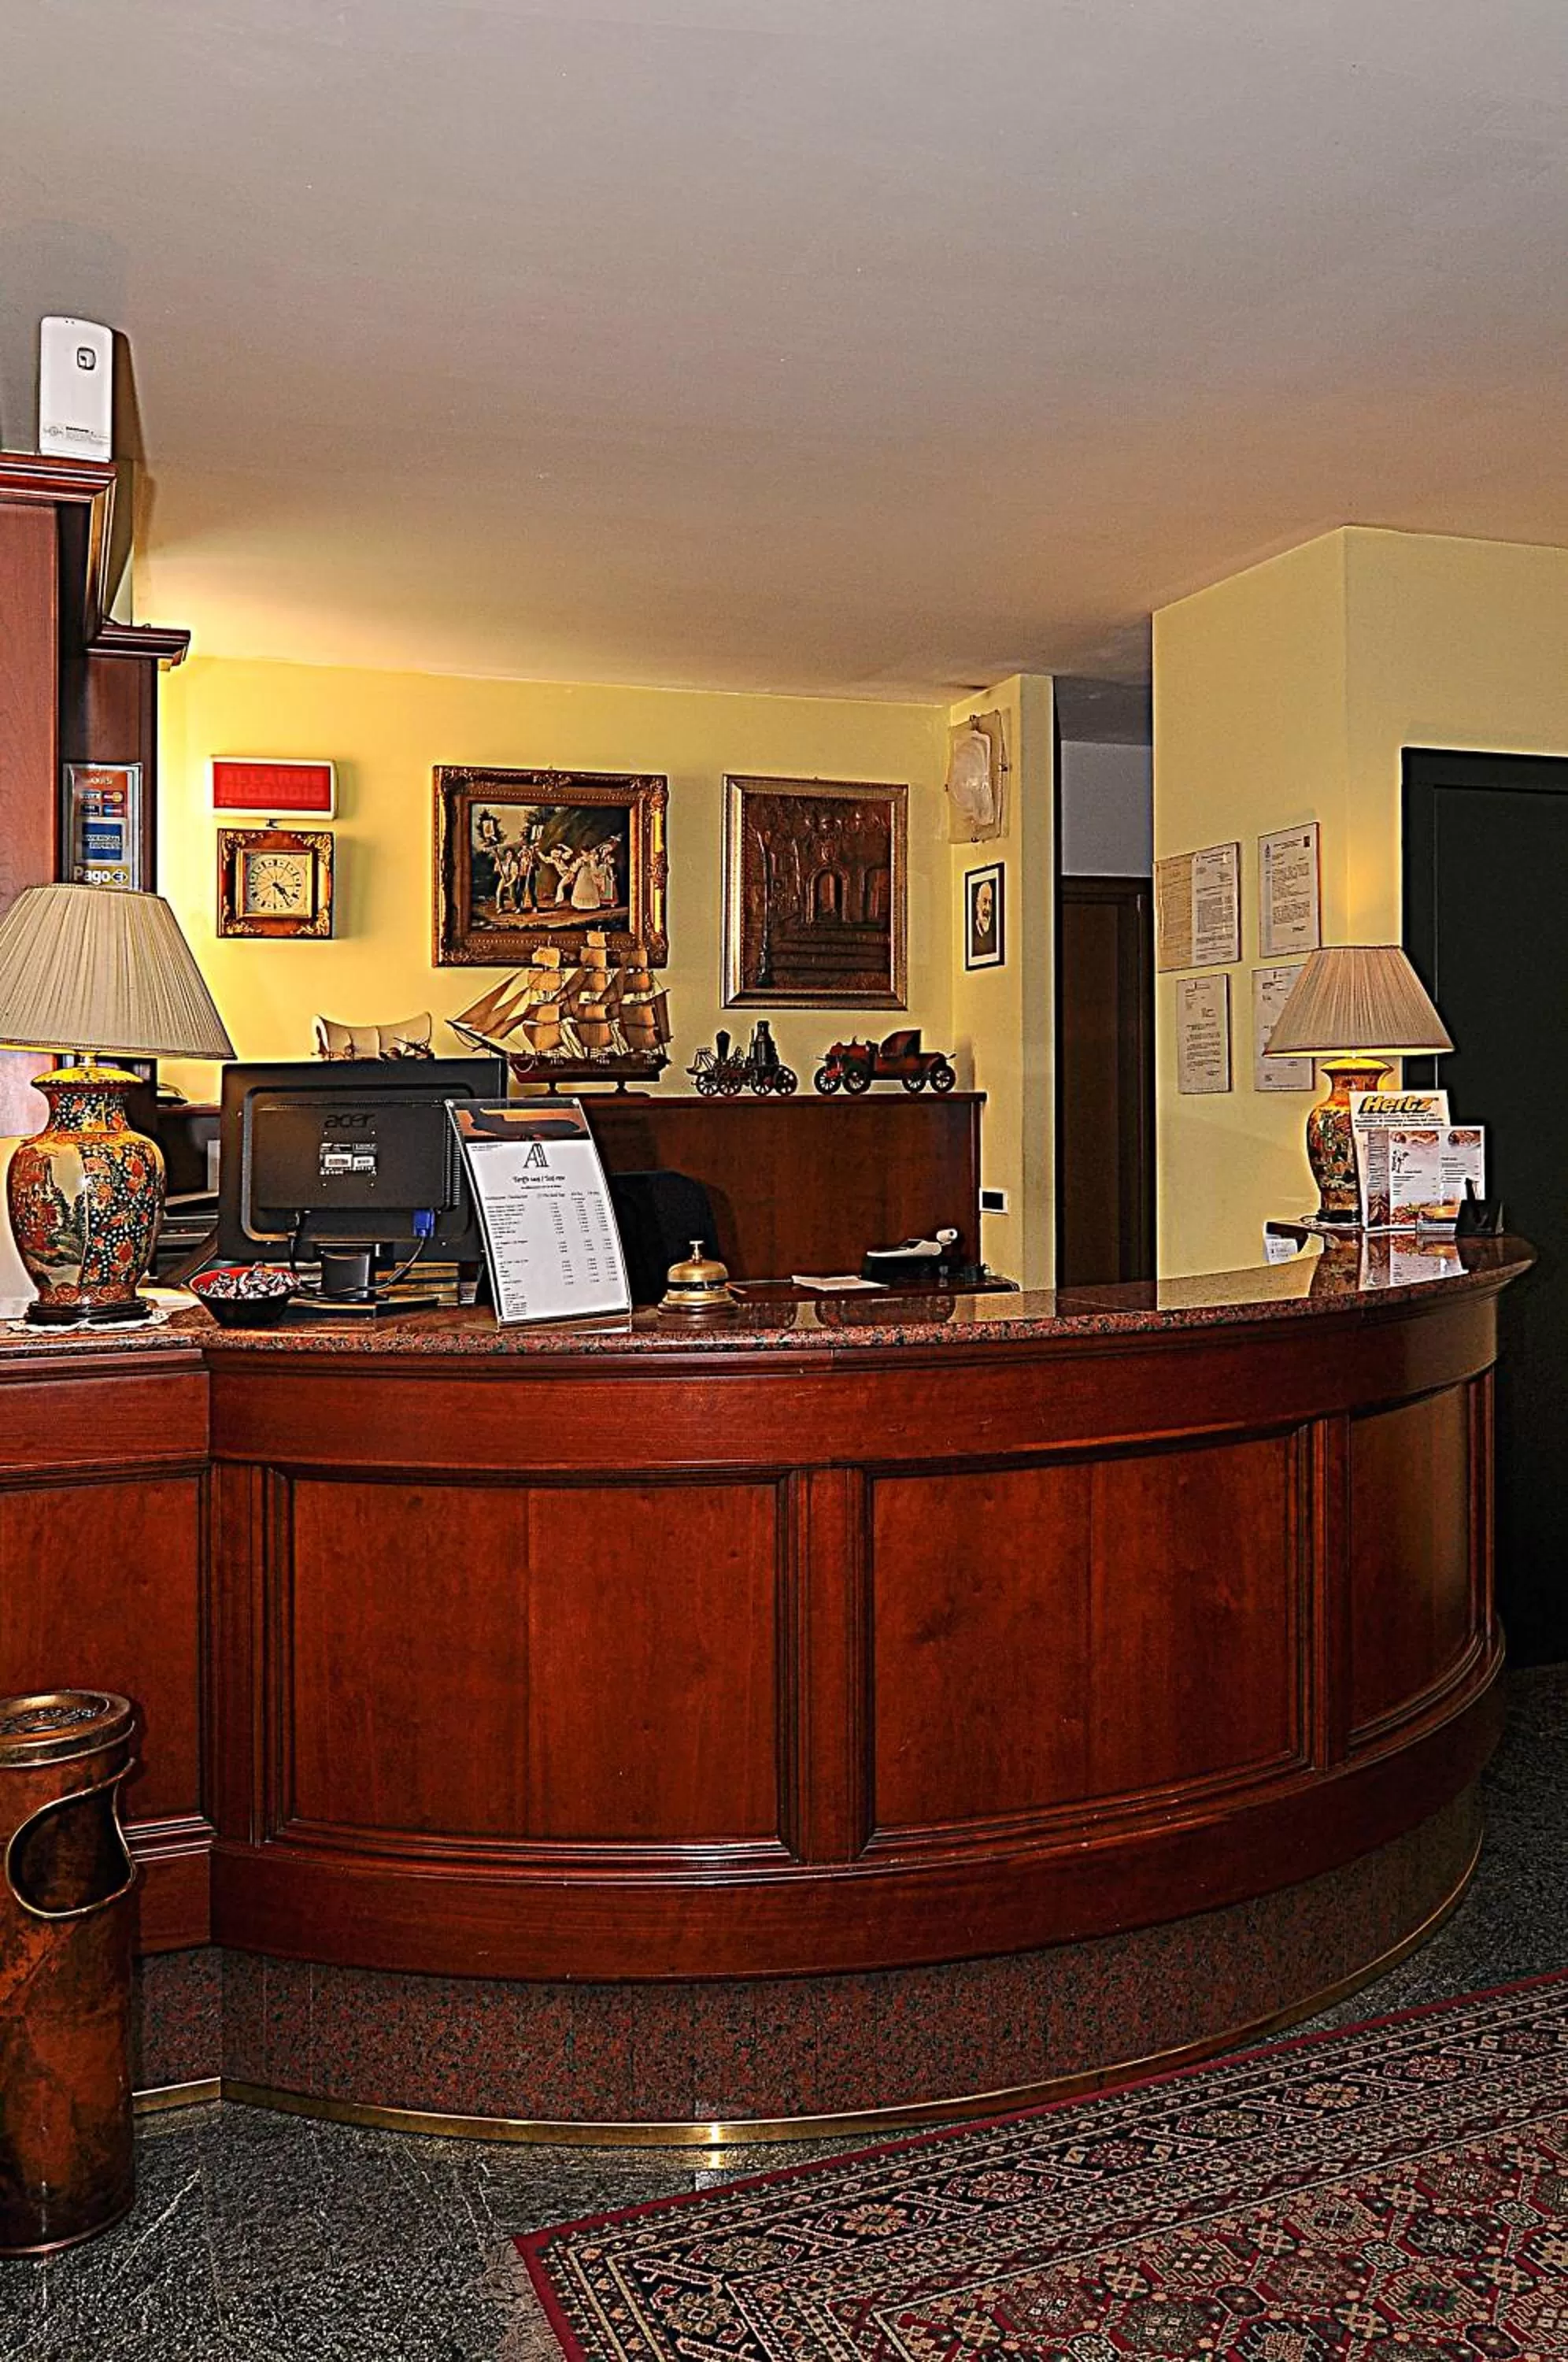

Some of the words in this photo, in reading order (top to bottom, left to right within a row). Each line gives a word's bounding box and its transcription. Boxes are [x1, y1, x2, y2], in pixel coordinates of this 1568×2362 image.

[73, 865, 110, 886] Pago
[1358, 1095, 1434, 1114] Hertz
[324, 1114, 375, 1128] acer
